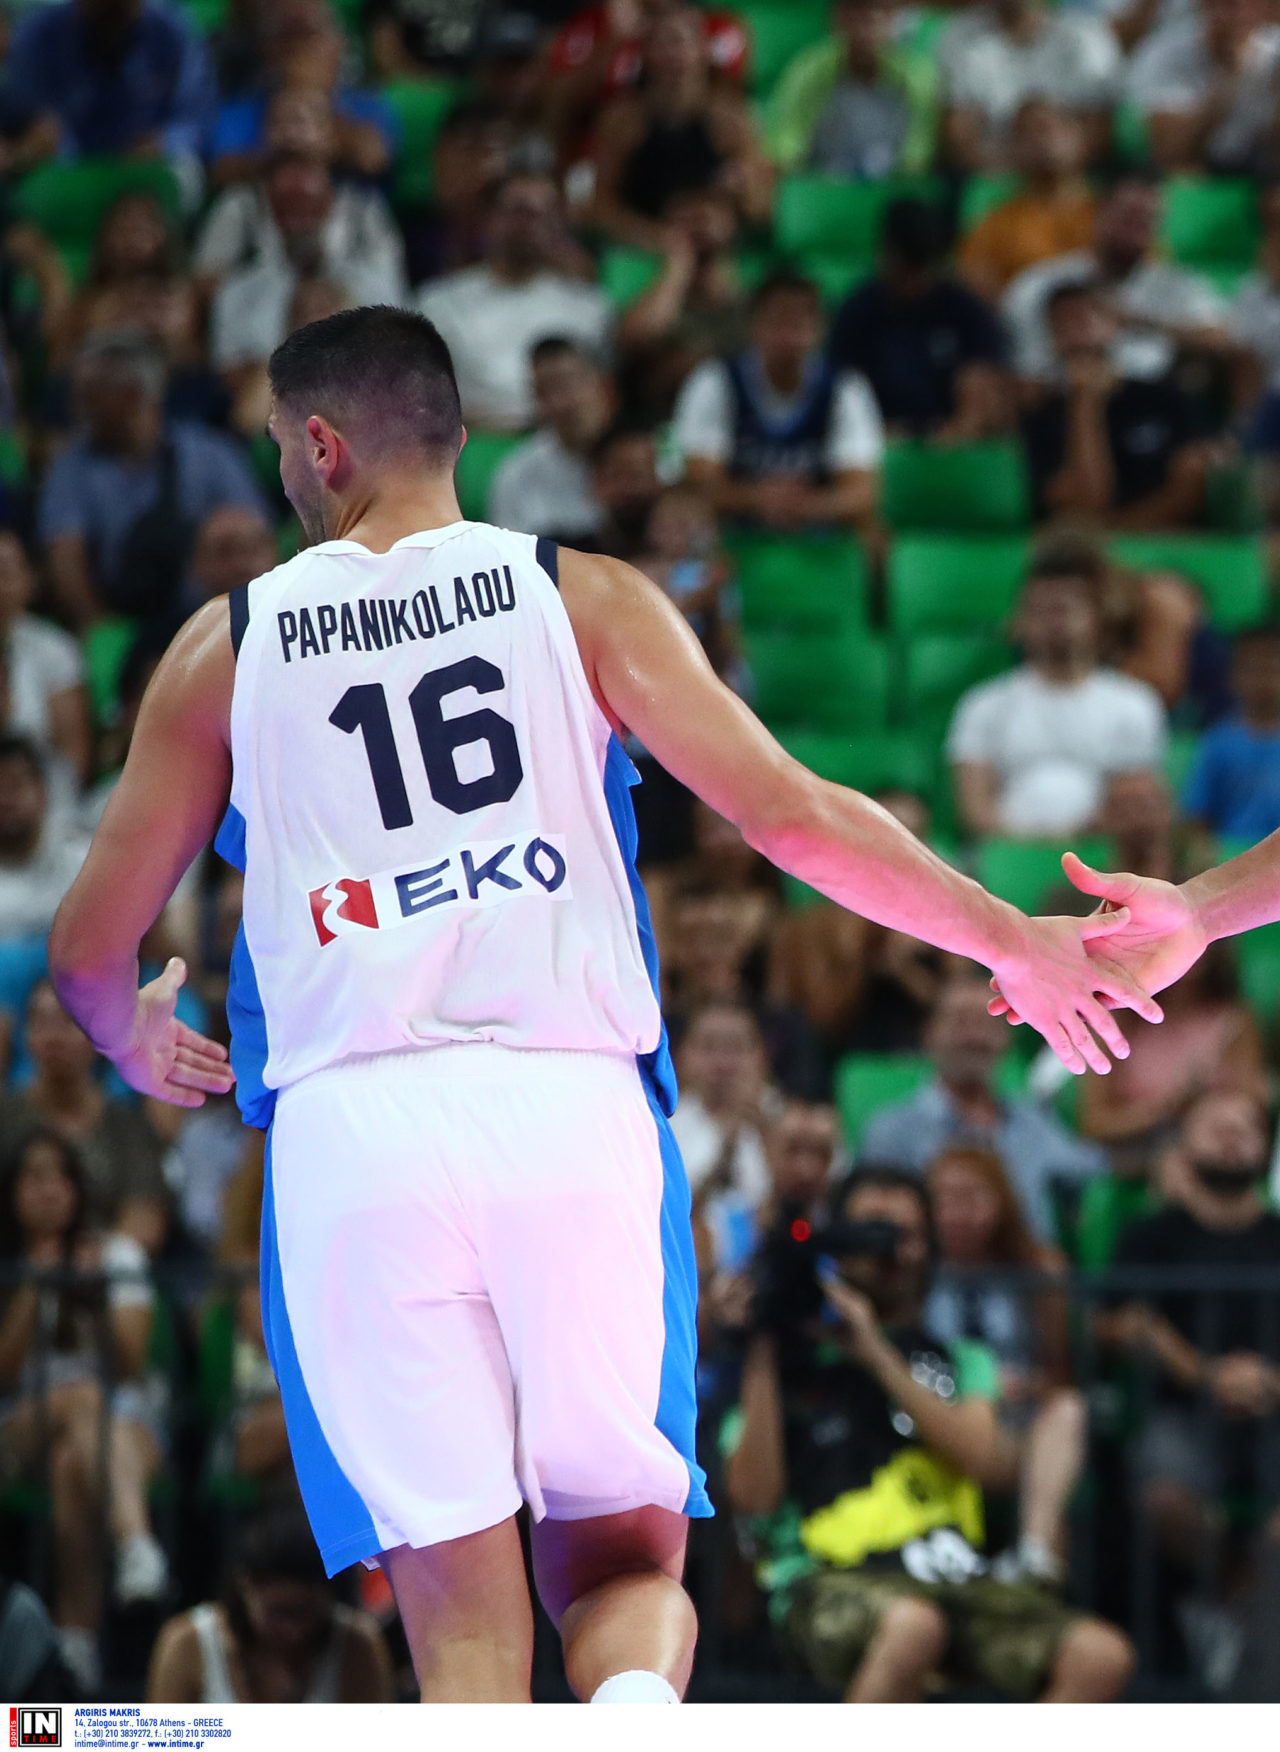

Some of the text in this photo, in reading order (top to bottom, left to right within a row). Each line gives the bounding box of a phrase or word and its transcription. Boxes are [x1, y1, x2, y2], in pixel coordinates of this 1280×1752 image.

[277, 565, 516, 663] PAPANIKOLAOU
[328, 655, 524, 831] 16
[394, 837, 567, 918] EKO
